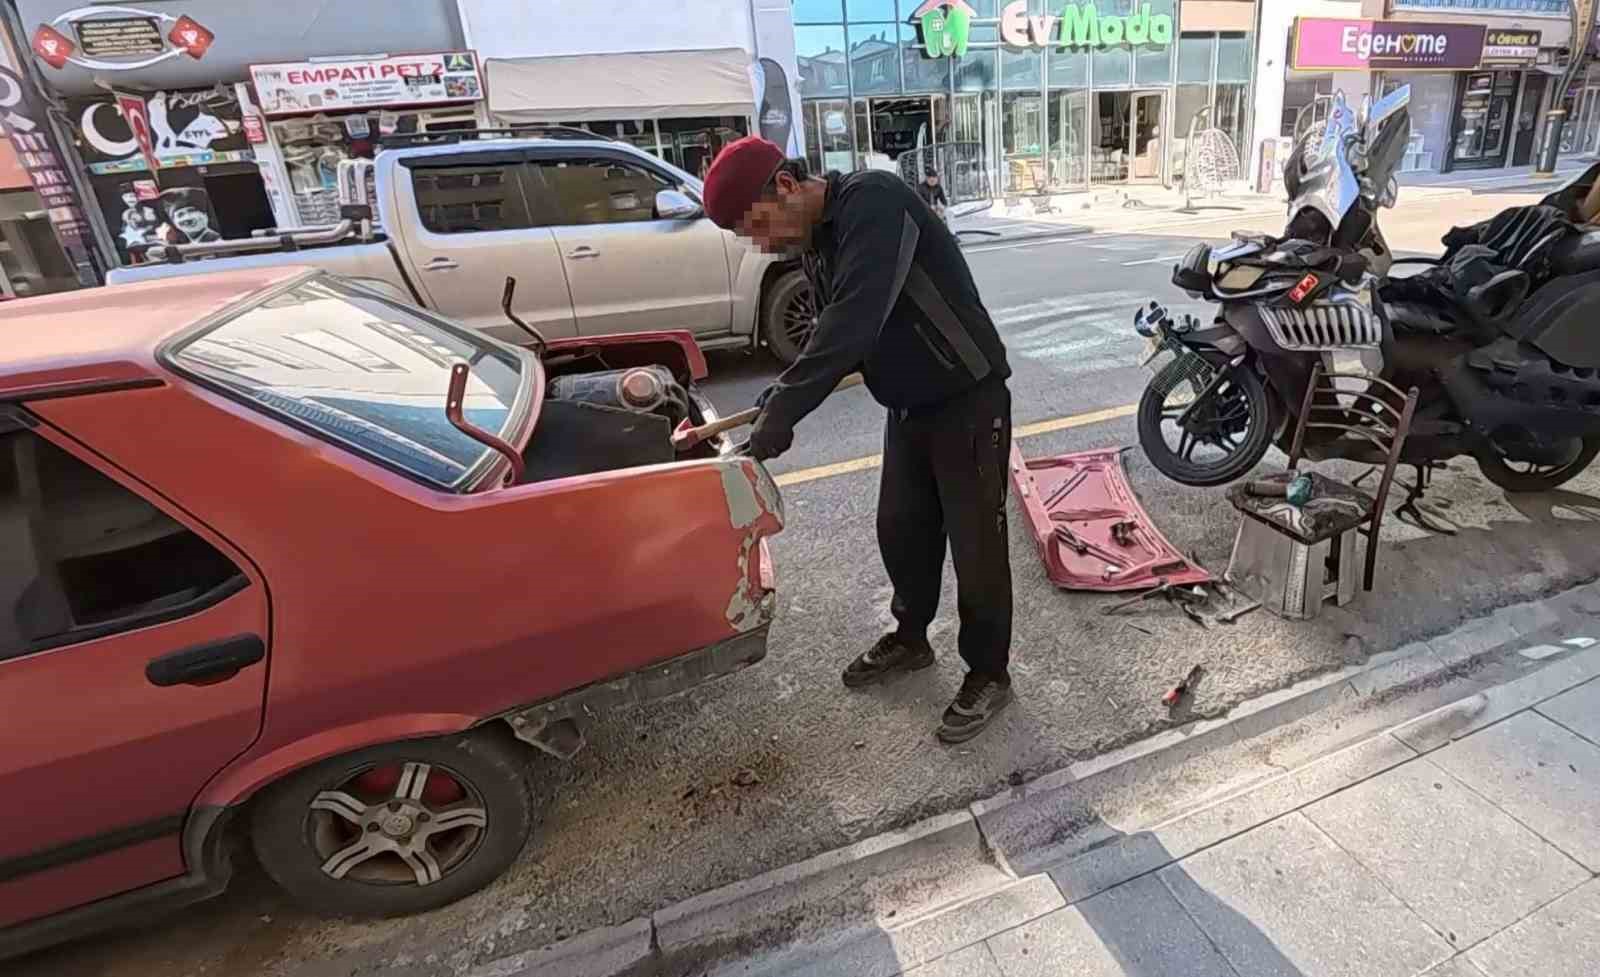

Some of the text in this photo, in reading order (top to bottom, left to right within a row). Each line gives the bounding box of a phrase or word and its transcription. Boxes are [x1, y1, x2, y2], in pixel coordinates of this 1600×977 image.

[287, 62, 375, 85] EMPATİ
[381, 62, 427, 79] PET
[432, 62, 444, 76] 2
